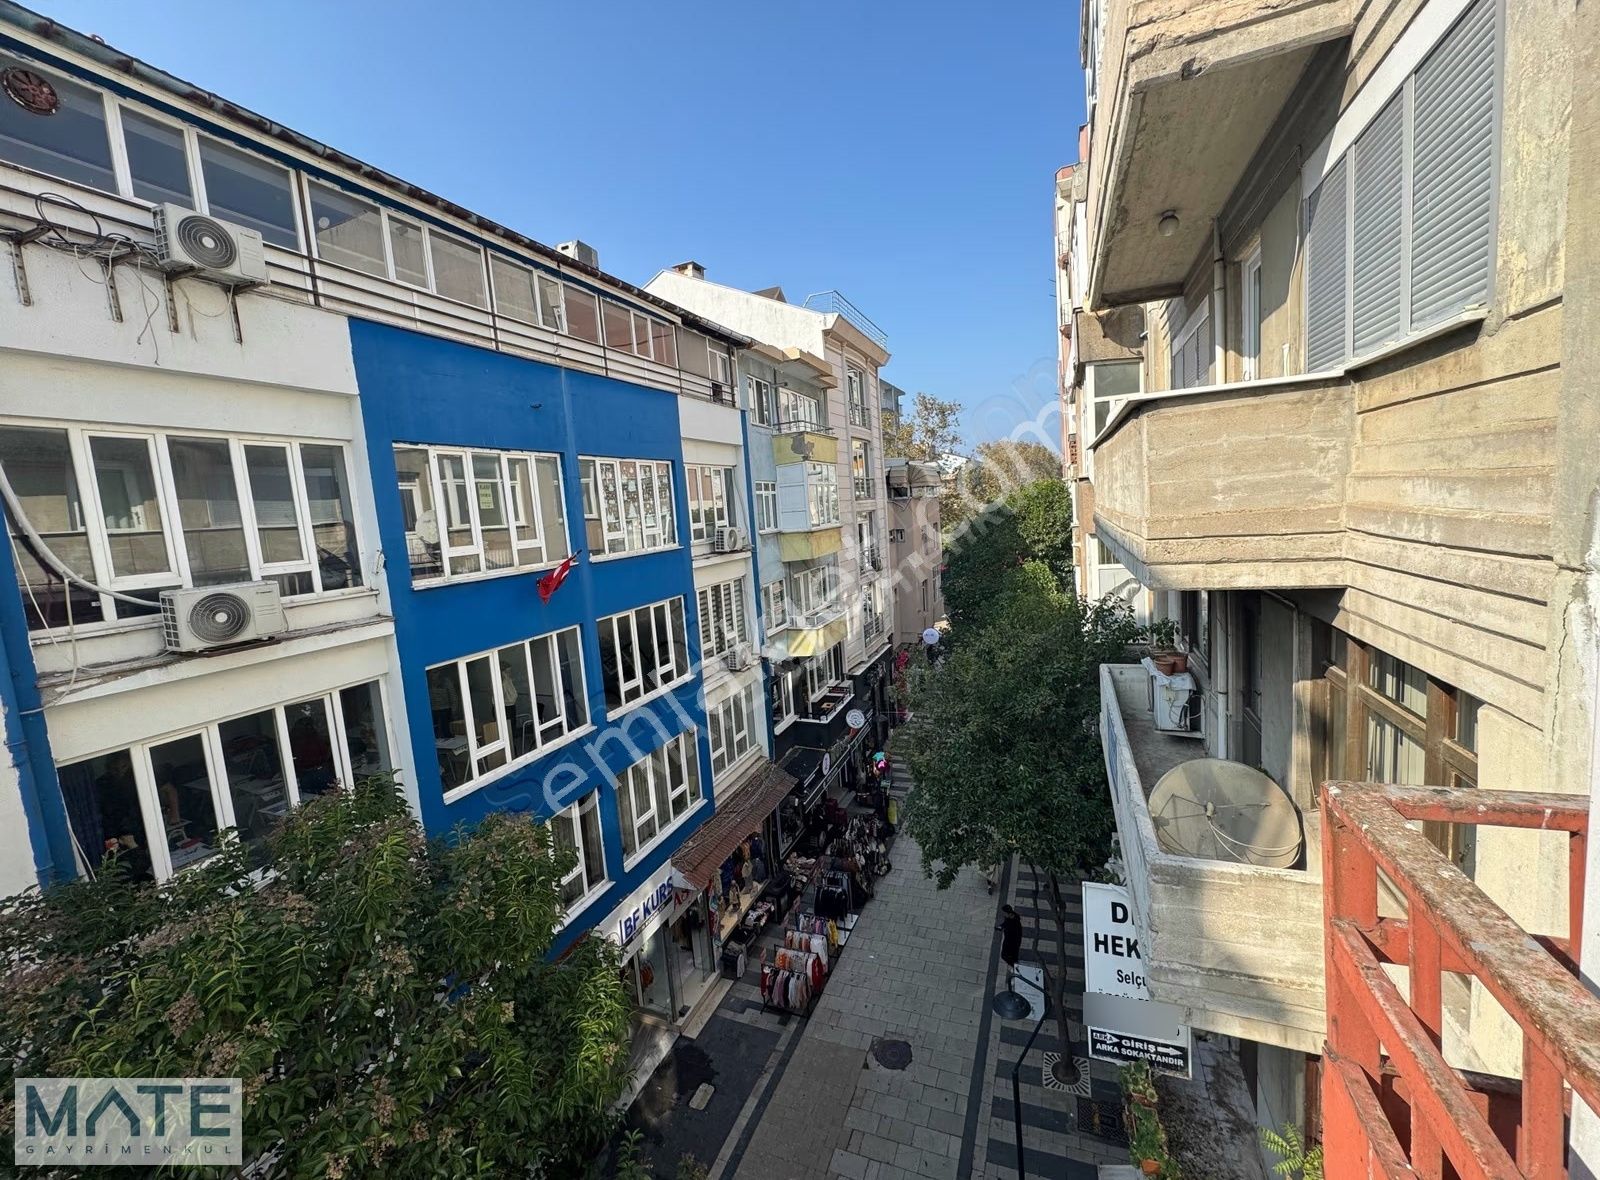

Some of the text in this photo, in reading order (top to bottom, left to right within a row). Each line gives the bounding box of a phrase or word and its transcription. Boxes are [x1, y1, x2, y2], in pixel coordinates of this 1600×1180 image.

[623, 907, 640, 940] BF
[642, 875, 673, 920] KURS
[1110, 901, 1135, 926] D
[1094, 932, 1141, 960] HEK
[1096, 1042, 1184, 1067] ARKA SOKAKTANDIR
